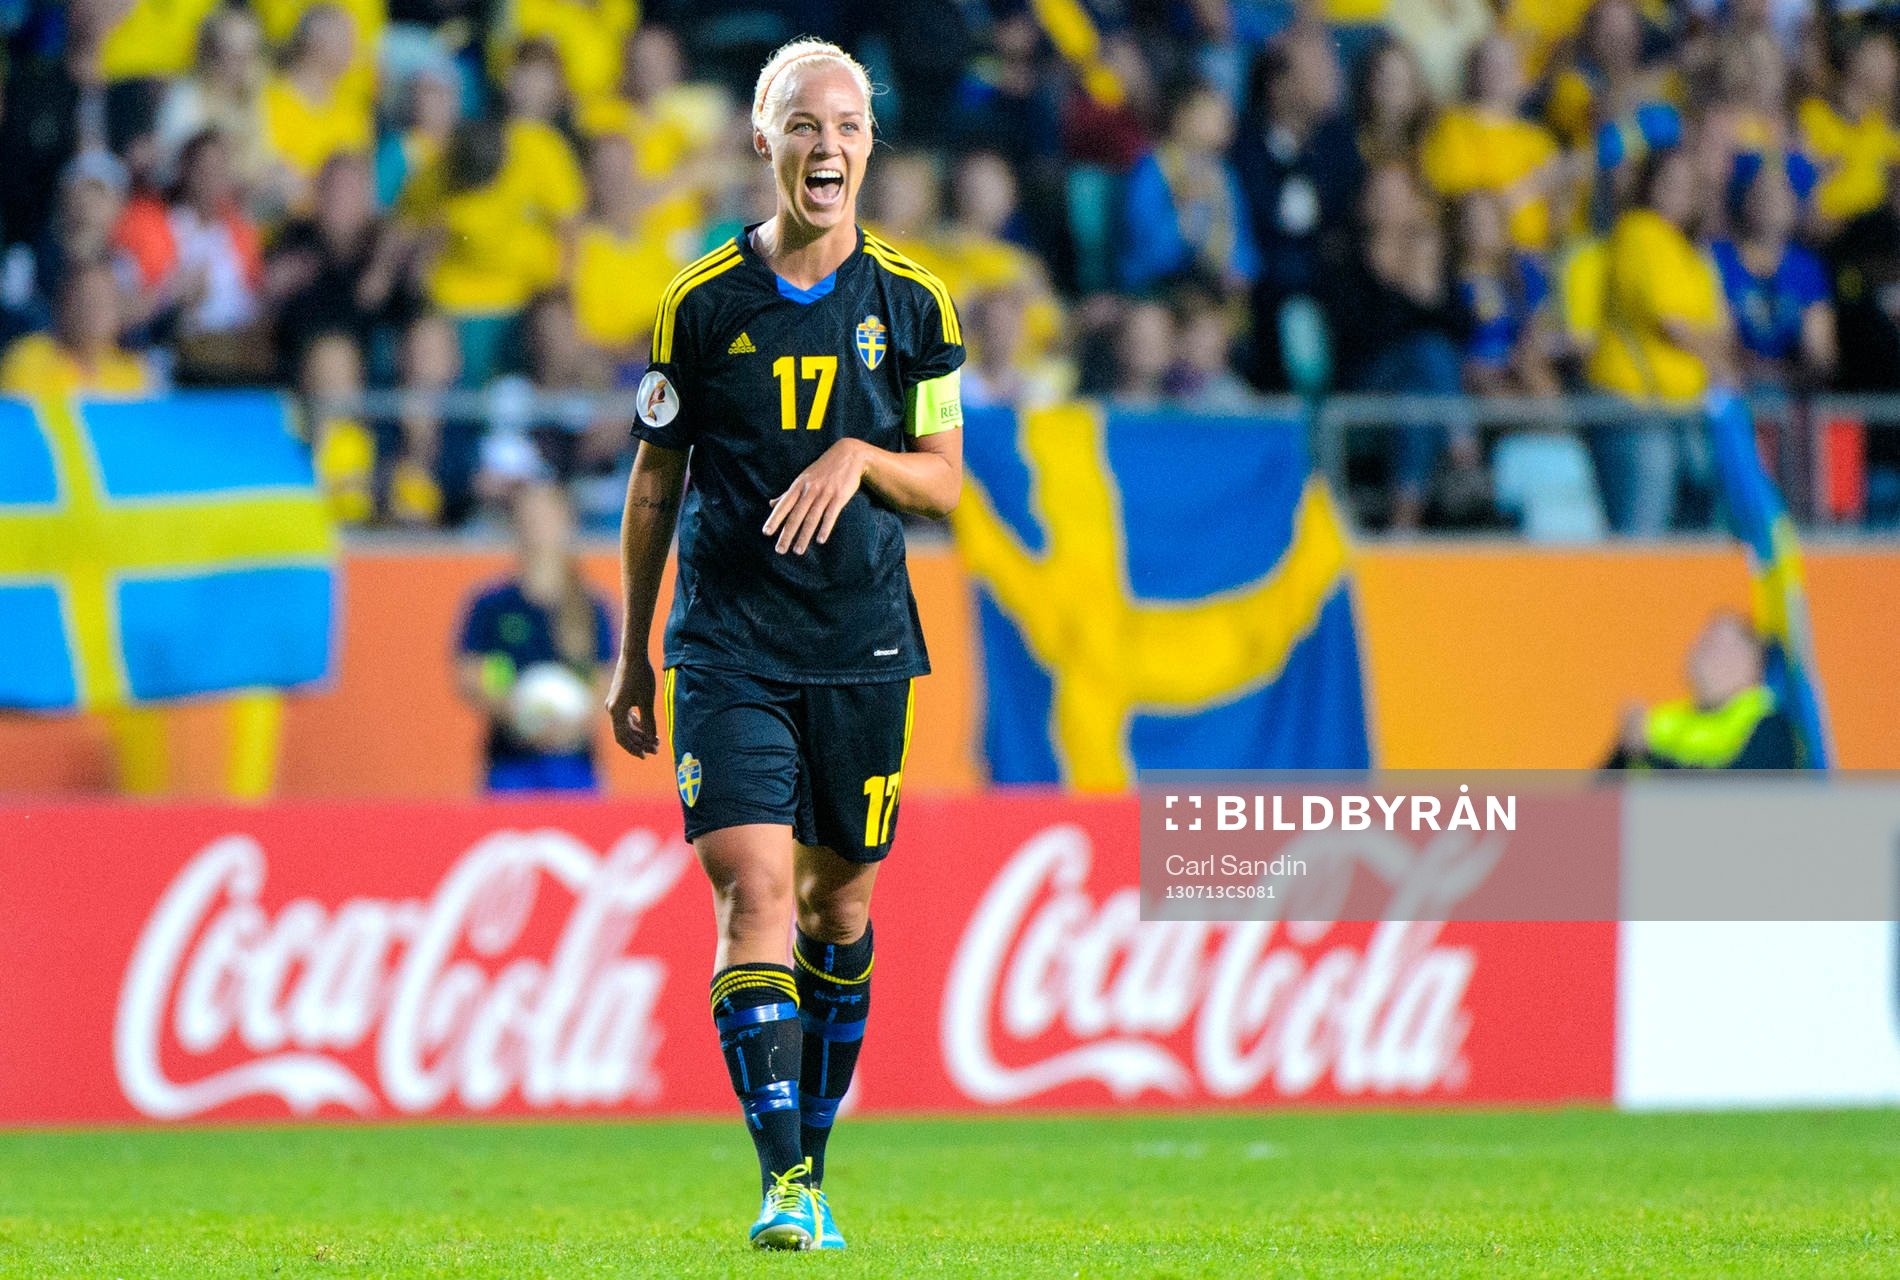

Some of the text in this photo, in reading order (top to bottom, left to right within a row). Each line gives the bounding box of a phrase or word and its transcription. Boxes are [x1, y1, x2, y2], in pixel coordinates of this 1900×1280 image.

[728, 344, 757, 355] adidas
[772, 355, 838, 430] 17
[863, 772, 898, 847] 17
